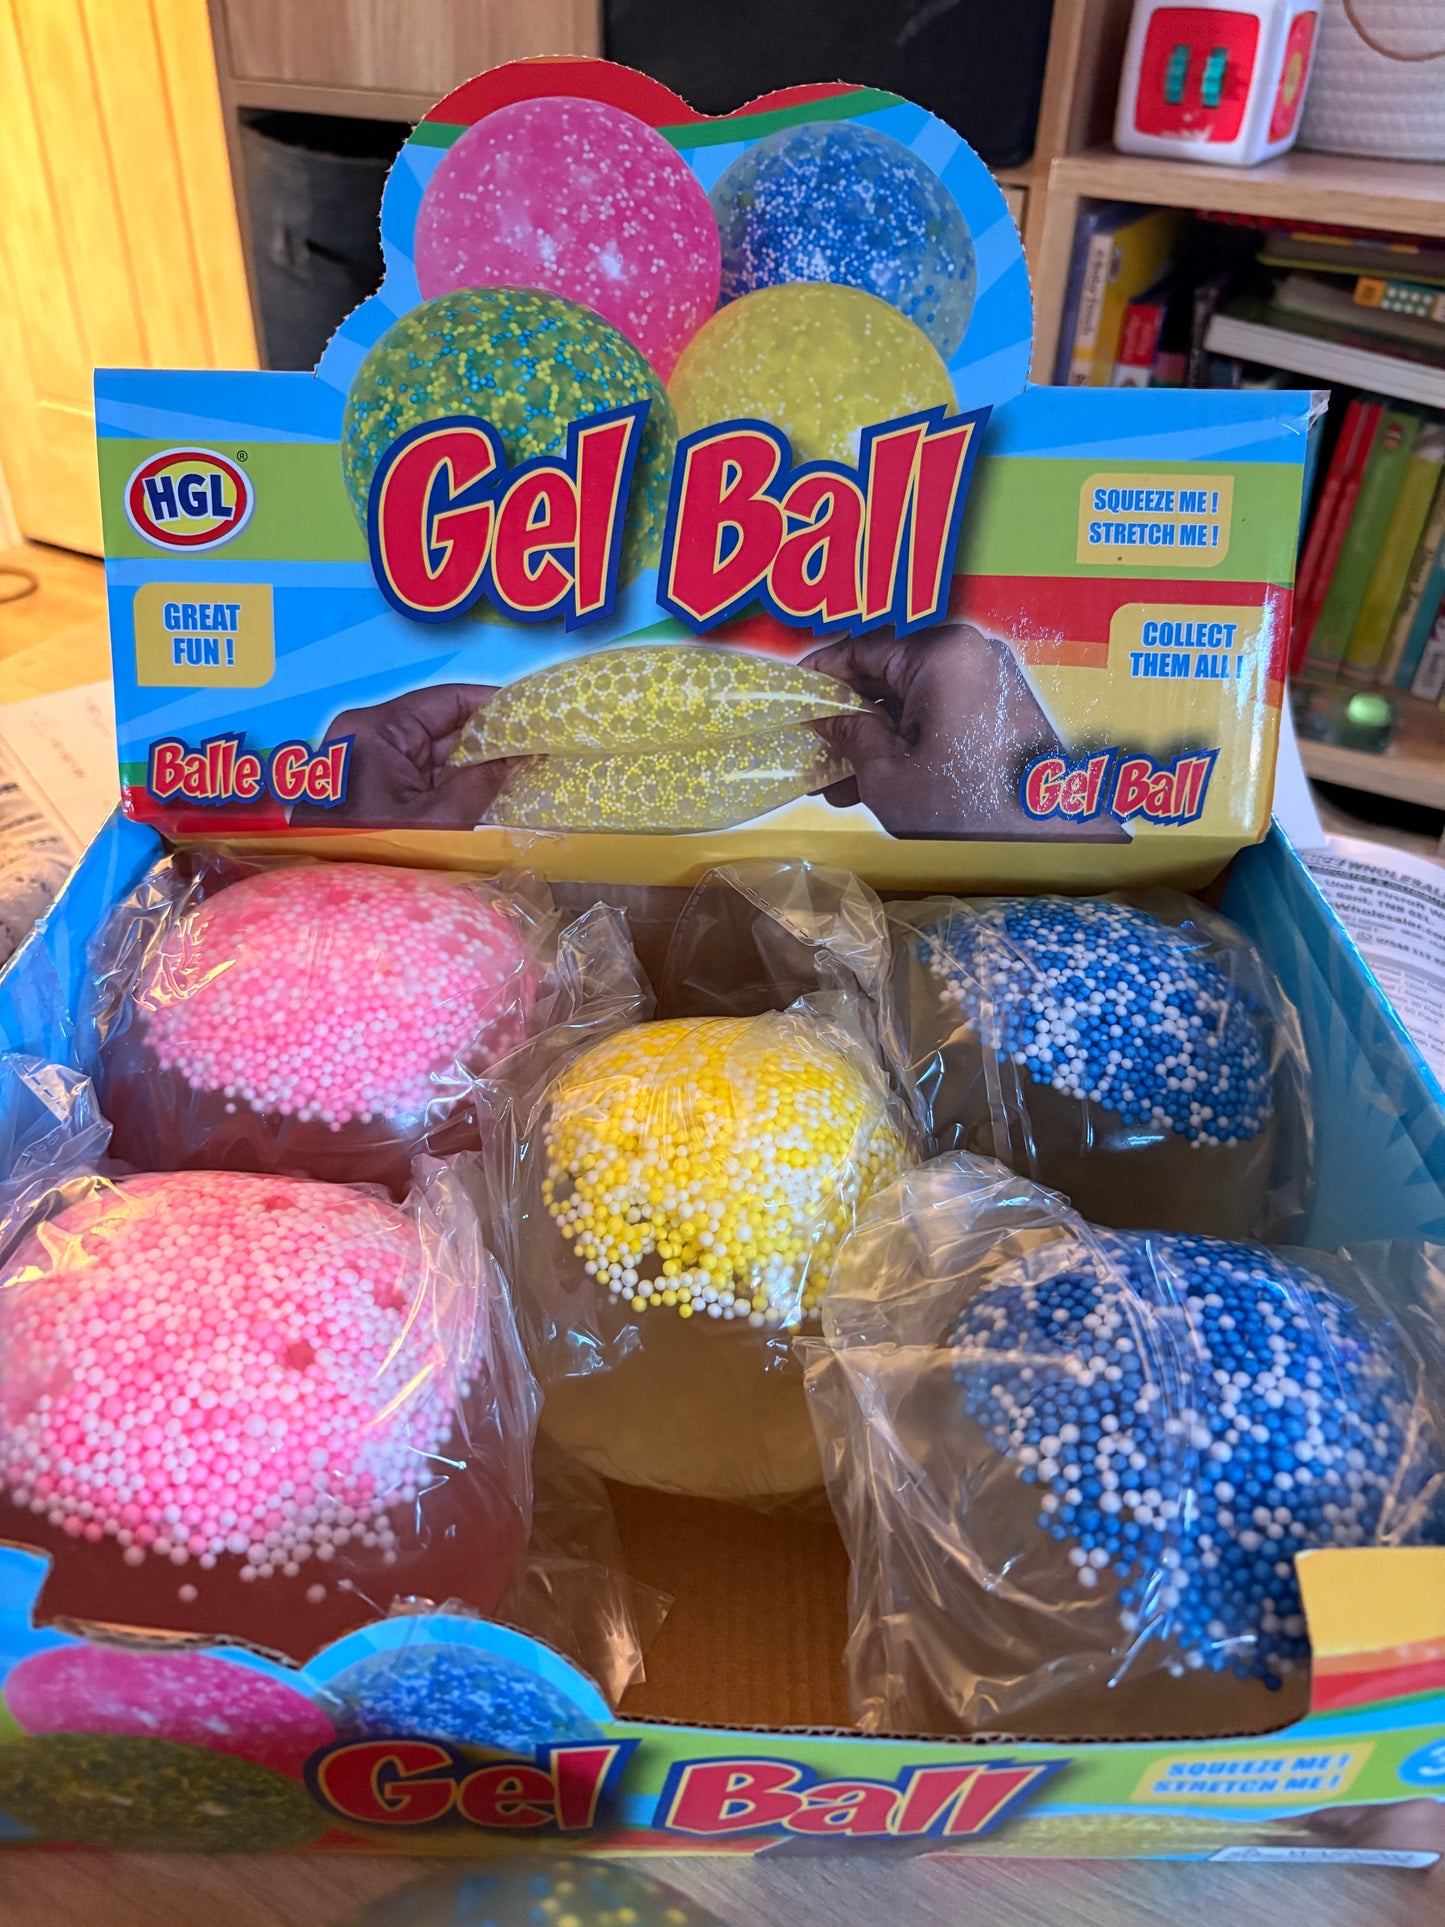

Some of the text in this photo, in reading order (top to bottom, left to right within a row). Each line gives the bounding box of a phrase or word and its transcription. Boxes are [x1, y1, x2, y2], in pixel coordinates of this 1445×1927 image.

[142, 472, 235, 521] HGL
[1093, 488, 1176, 515] SQUEEZE
[378, 415, 974, 623] Gel Ball
[1088, 521, 1176, 546] STRETCH
[163, 602, 241, 632] GREAT
[1141, 621, 1238, 649] COLLECT
[1129, 652, 1192, 678] THEM
[150, 739, 262, 801] Balle
[270, 738, 351, 802] Gel
[1024, 754, 1210, 819] Gel Ball
[1166, 1758, 1288, 1777] SQUEEZE
[317, 1740, 1048, 1837] Gel Ball
[1152, 1779, 1280, 1794] STRETCH
